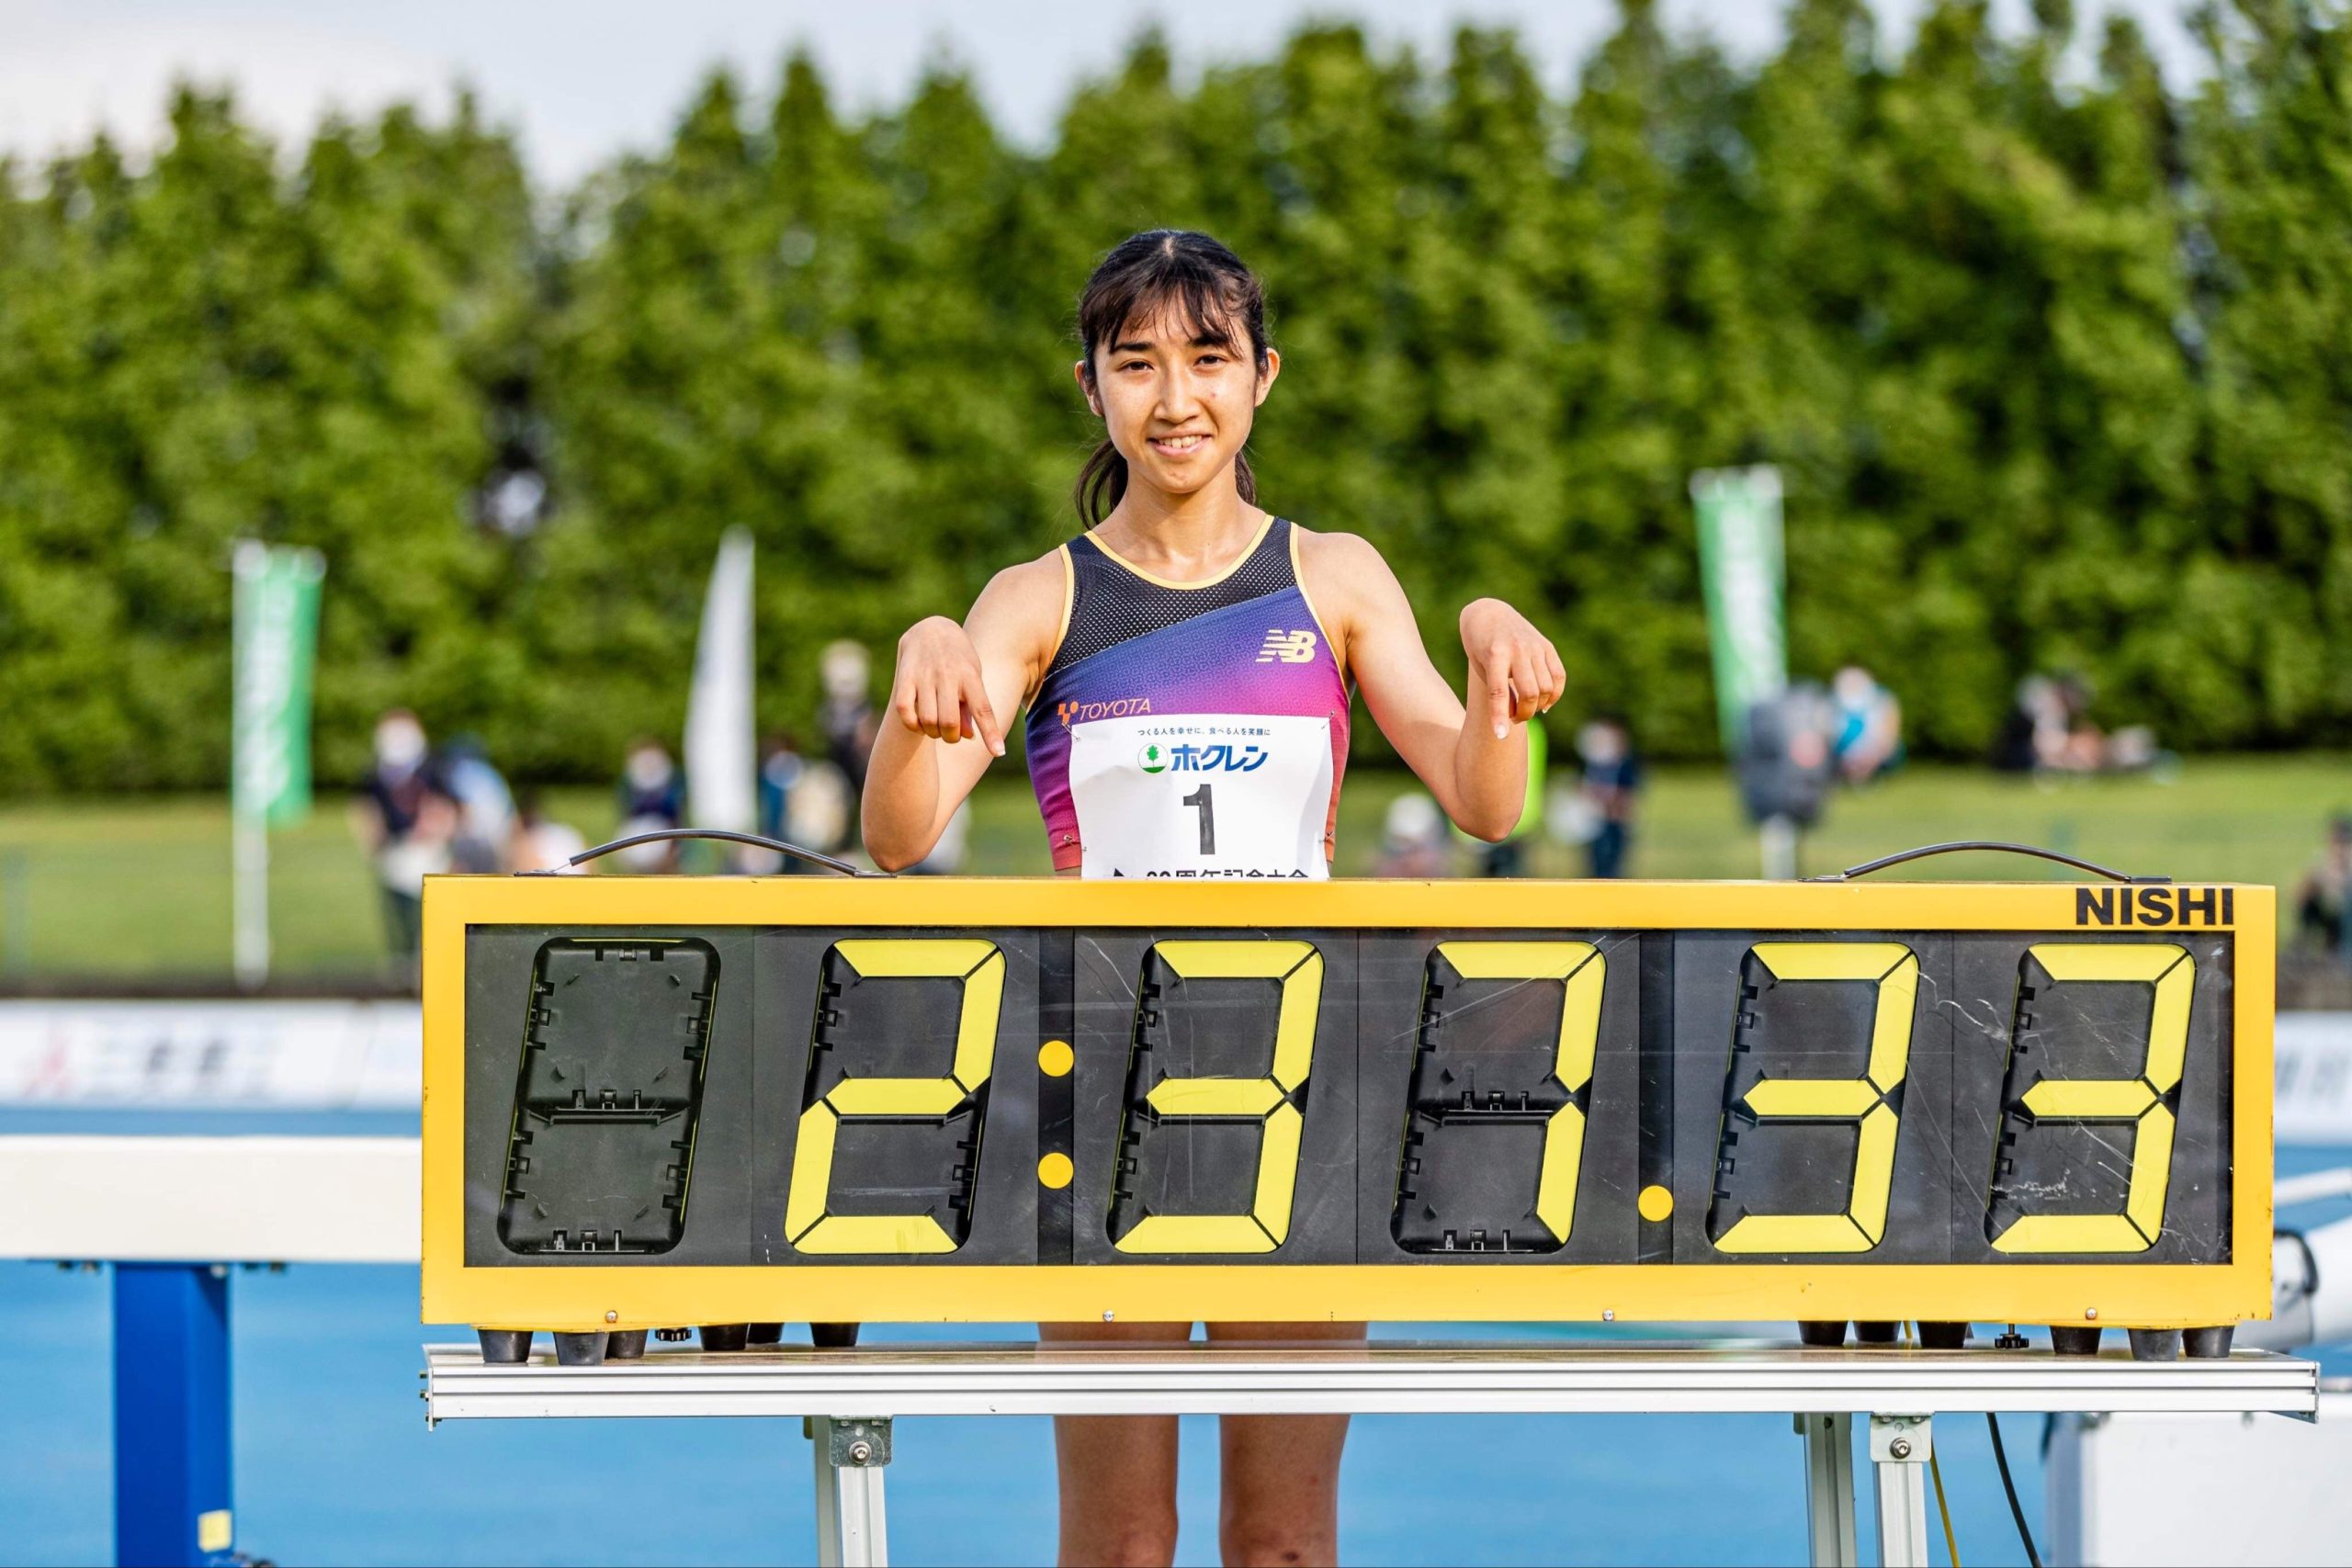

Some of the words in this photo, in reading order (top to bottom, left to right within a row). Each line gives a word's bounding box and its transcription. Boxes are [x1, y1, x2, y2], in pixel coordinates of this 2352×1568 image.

[1080, 698, 1151, 721] TOYOTA
[1170, 743, 1269, 773] ホクレン
[1182, 784, 1216, 855] 1
[2075, 887, 2234, 926] NISHI
